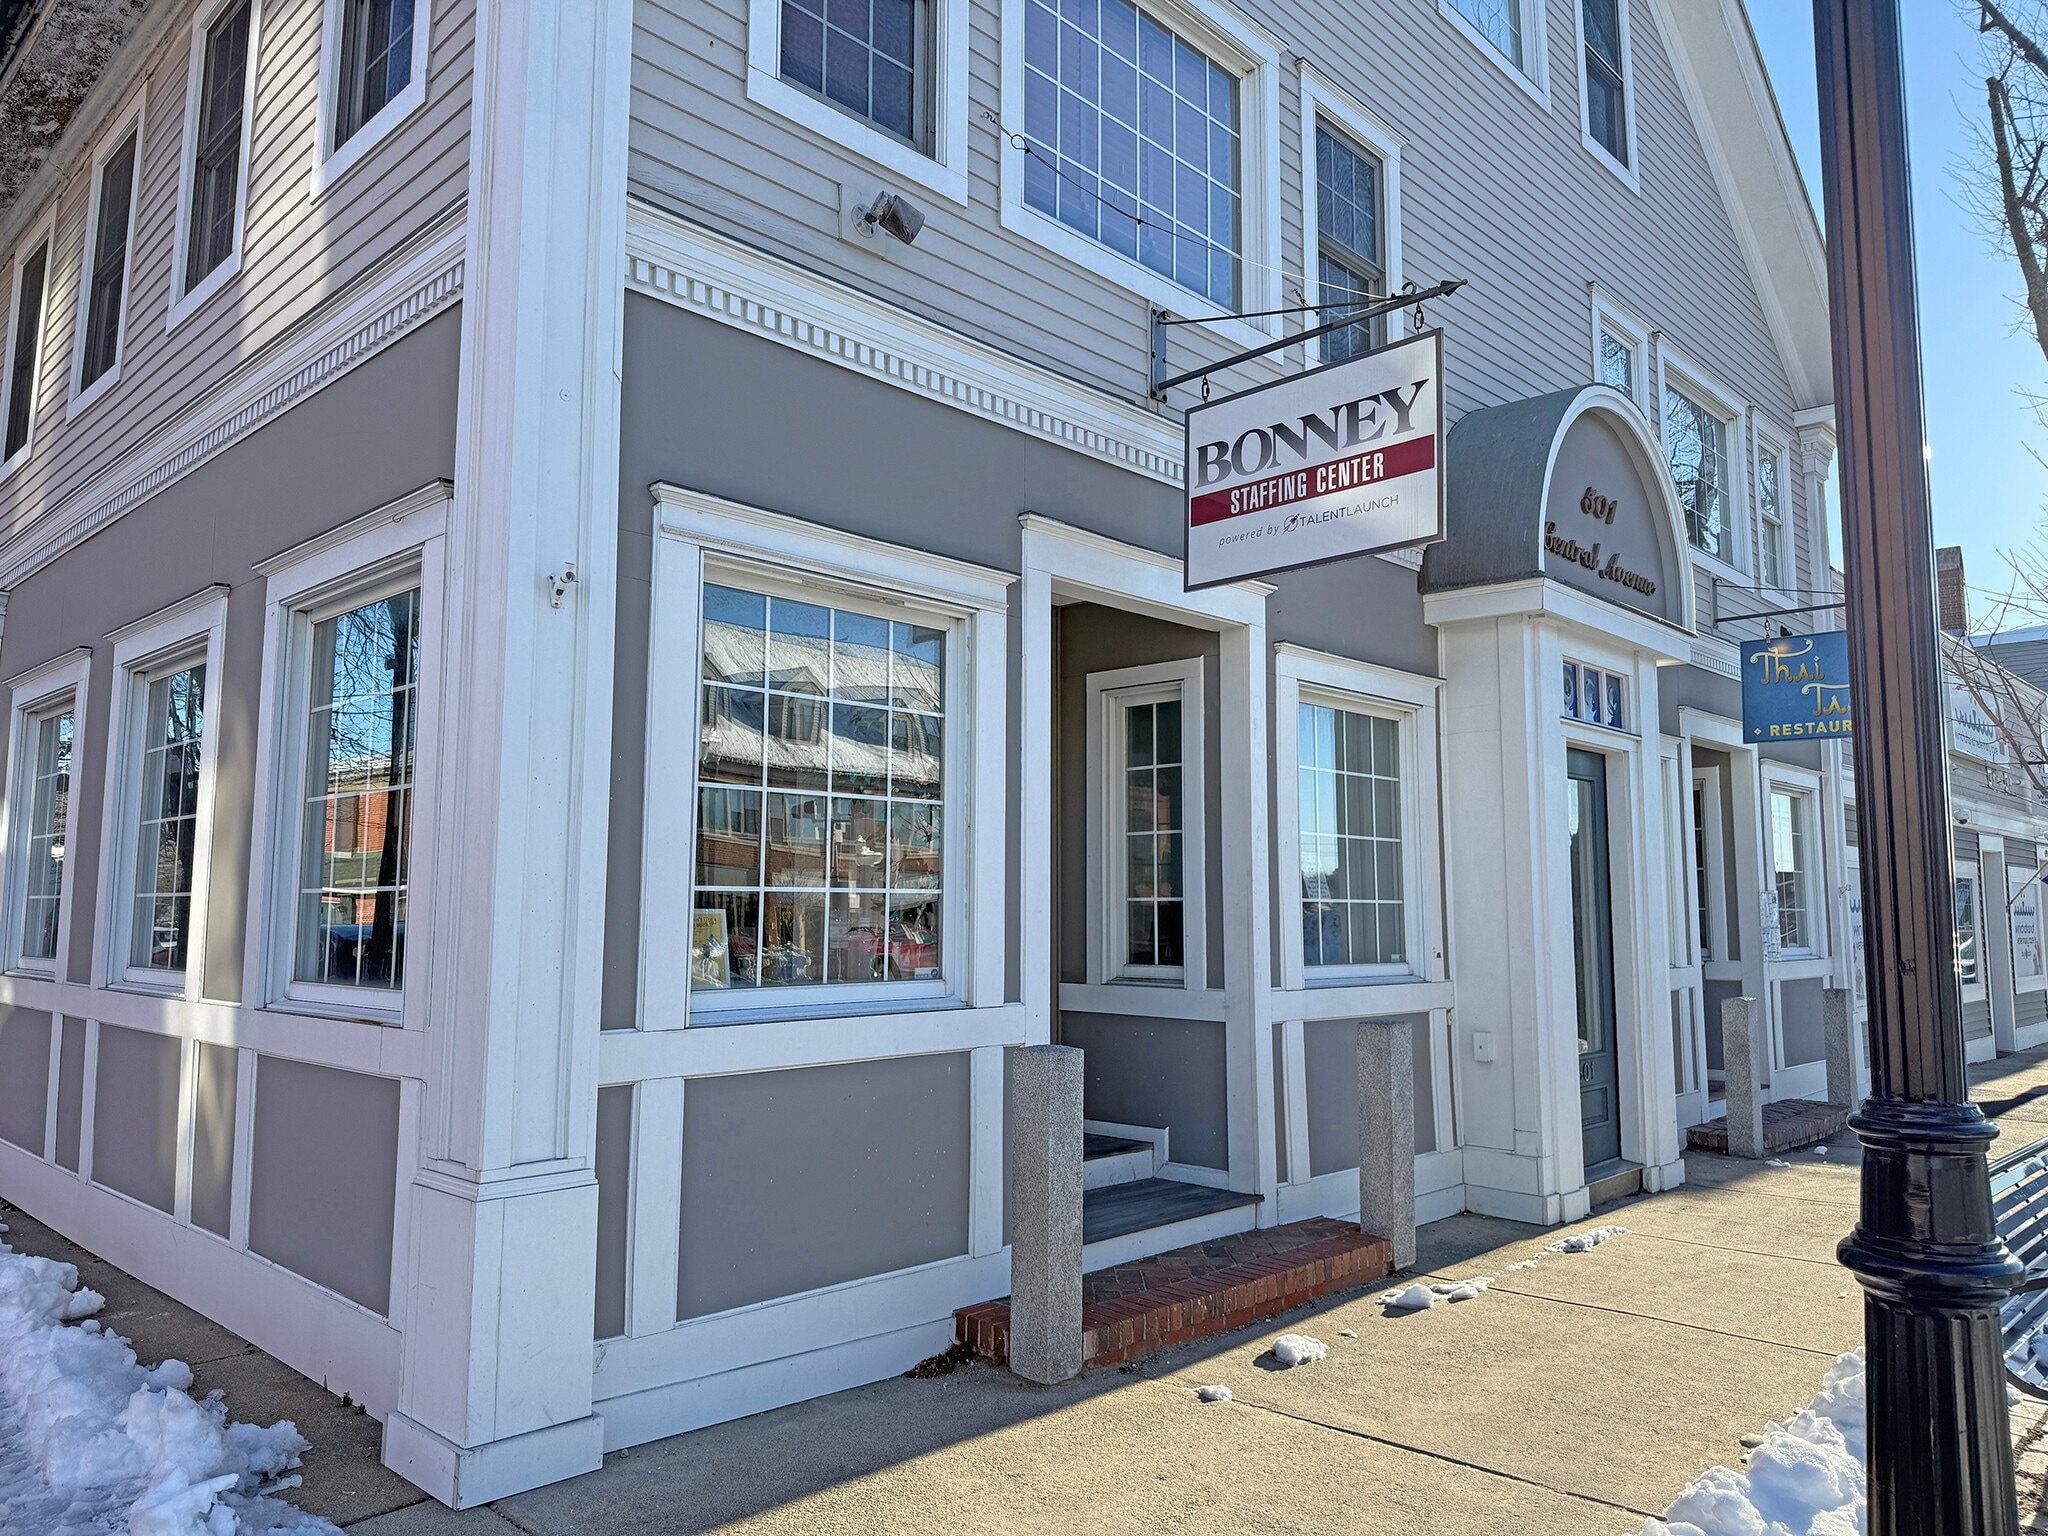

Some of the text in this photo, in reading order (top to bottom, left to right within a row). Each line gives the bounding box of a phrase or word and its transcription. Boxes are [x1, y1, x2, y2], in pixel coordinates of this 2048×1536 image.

[1194, 378, 1430, 489] BONNEY
[1230, 452, 1385, 515] STAFFING CENTER
[1580, 486, 1618, 525] 601
[1218, 494, 1400, 548] powered by TALENTLAUNCH
[1544, 520, 1657, 597] Central Avenue
[1750, 638, 1825, 685] Thai
[1801, 682, 1852, 717] Ta
[1579, 1061, 1595, 1082] 01
